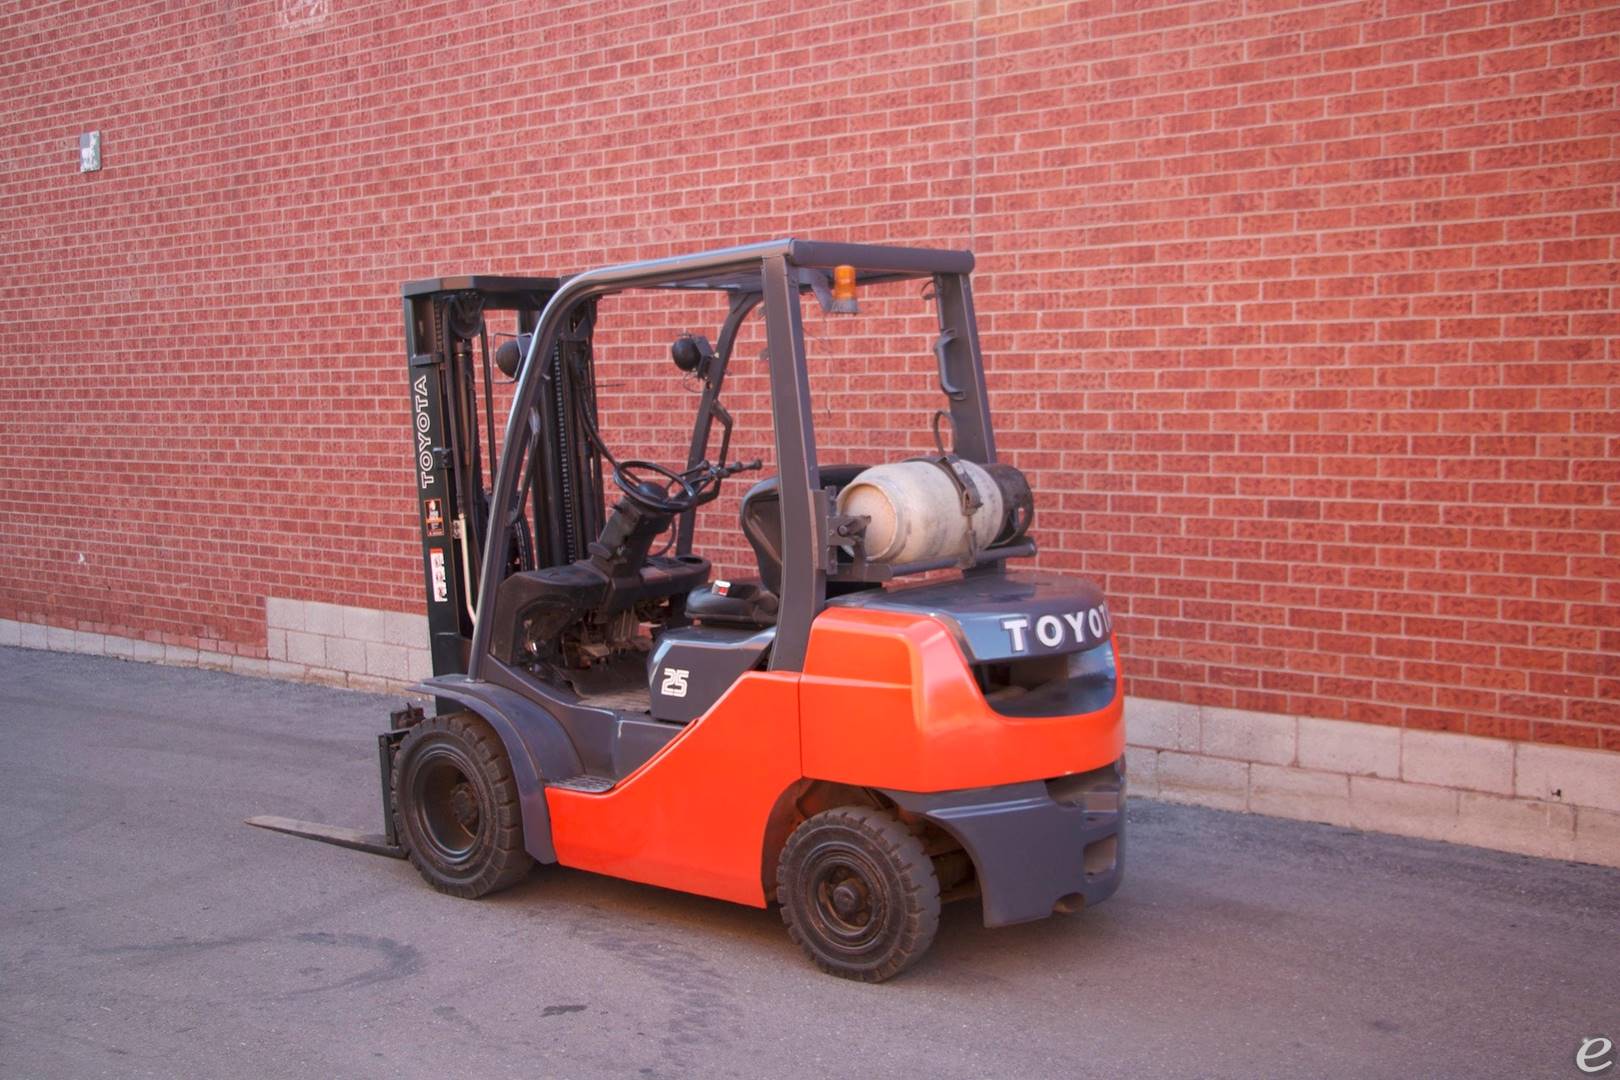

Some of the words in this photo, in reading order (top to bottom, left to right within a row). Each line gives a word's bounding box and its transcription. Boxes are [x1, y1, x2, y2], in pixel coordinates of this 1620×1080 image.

[414, 374, 434, 489] TOYOTA
[1003, 604, 1109, 651] TOYOT
[661, 667, 689, 697] 25
